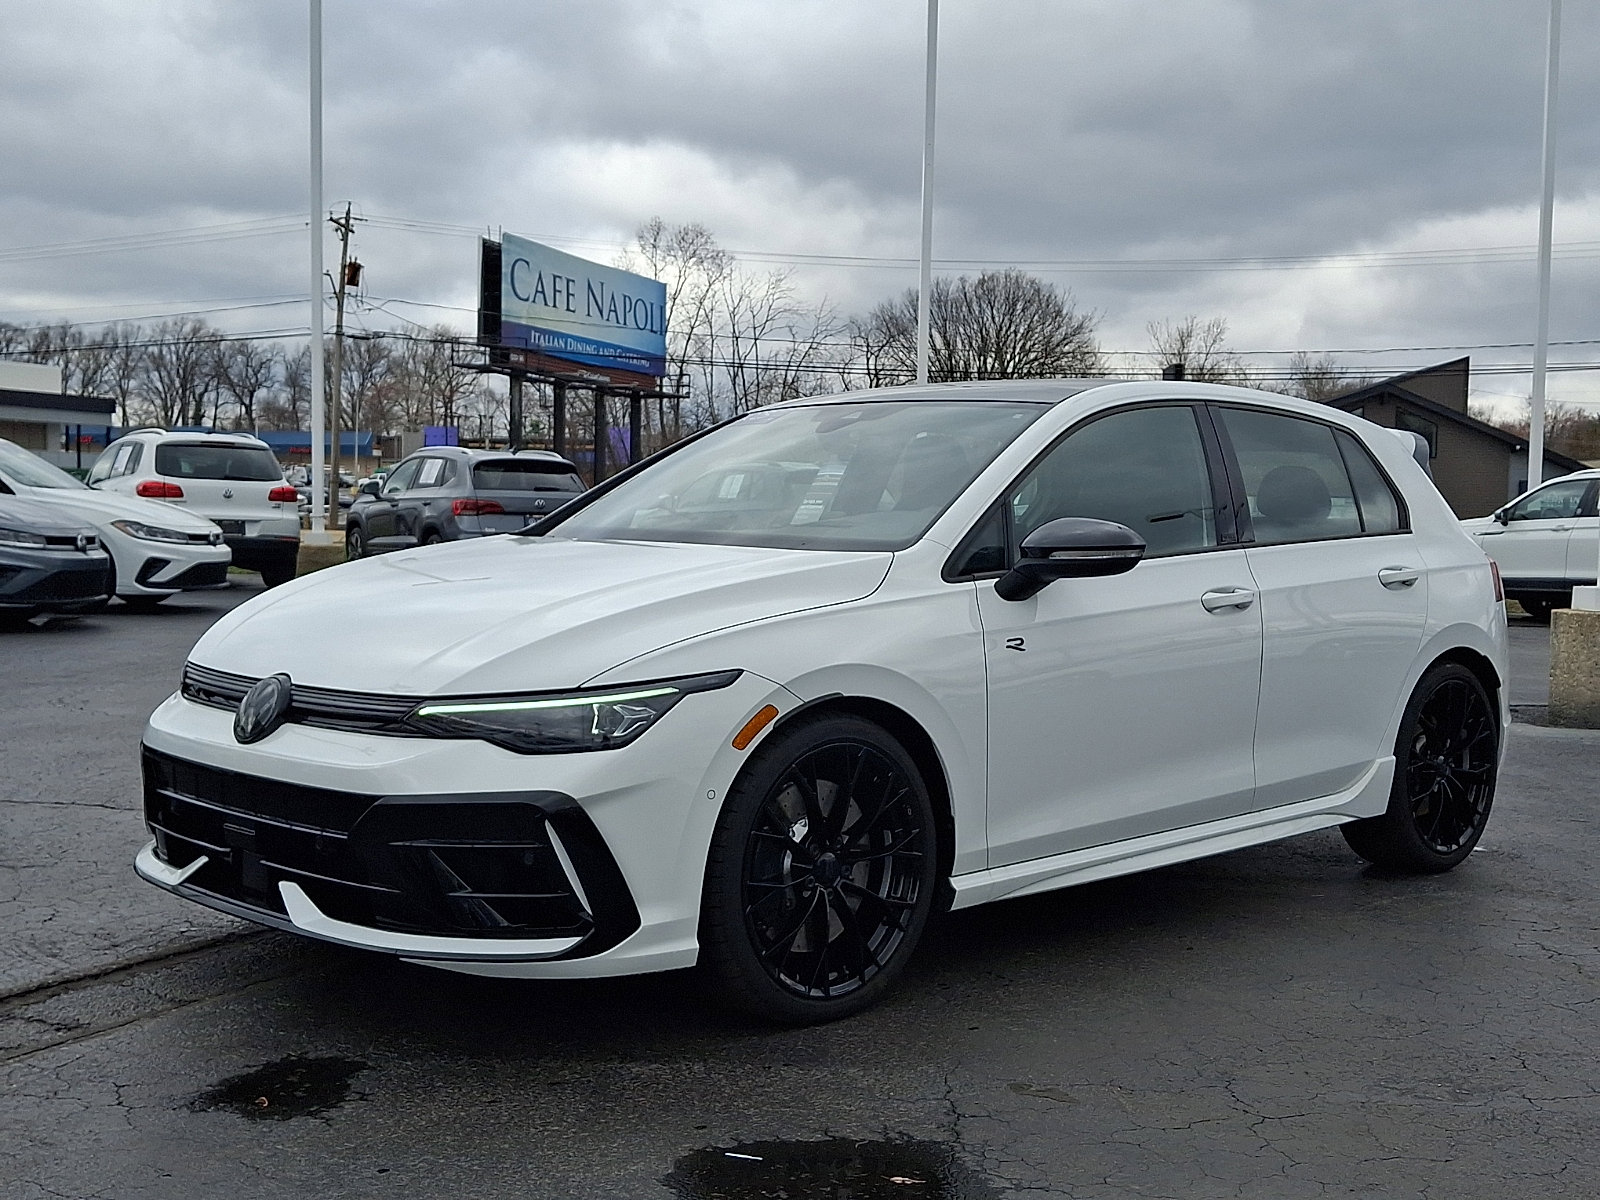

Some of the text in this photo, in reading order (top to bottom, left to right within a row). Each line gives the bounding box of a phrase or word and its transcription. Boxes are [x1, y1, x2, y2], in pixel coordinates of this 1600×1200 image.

[510, 258, 665, 336] CAFE NAPOLI
[530, 330, 566, 349] ITALIAN
[567, 337, 598, 355] DINING
[1006, 637, 1026, 652] R
